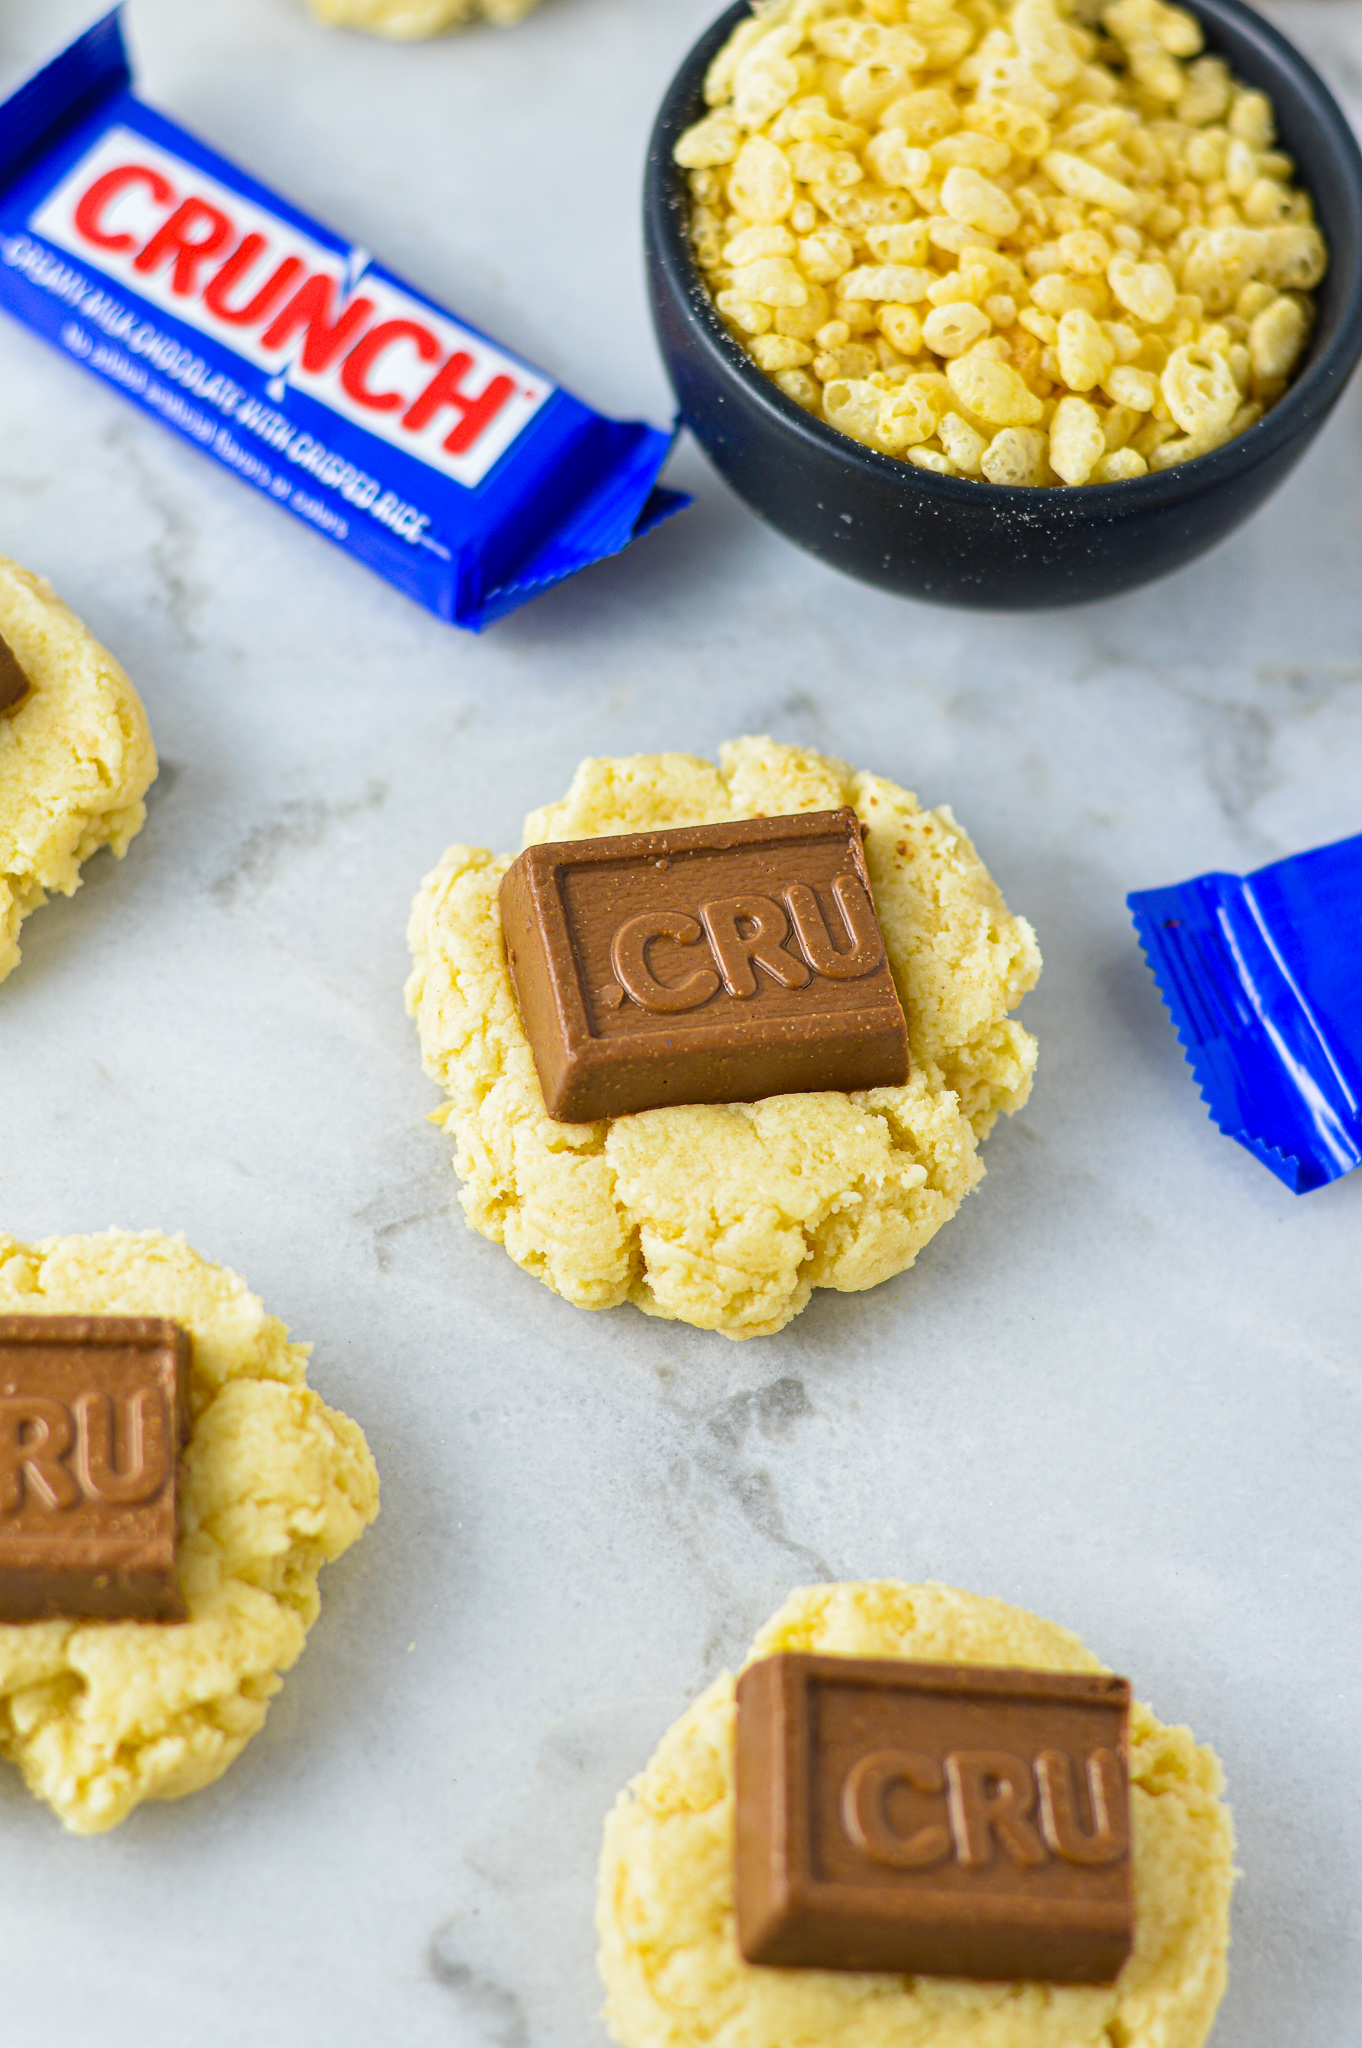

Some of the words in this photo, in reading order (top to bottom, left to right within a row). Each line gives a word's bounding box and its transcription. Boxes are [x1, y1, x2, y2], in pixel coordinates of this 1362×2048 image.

[2, 235, 93, 307] CREAMY
[80, 288, 140, 341] MILK
[127, 321, 245, 416] CHOCOLATE
[235, 397, 297, 451] WITH
[286, 432, 380, 509] CRISPED
[370, 491, 431, 544] RICE
[75, 165, 516, 454] CRUNCH
[611, 873, 886, 1014] CRU
[842, 1747, 1129, 1868] CRU
